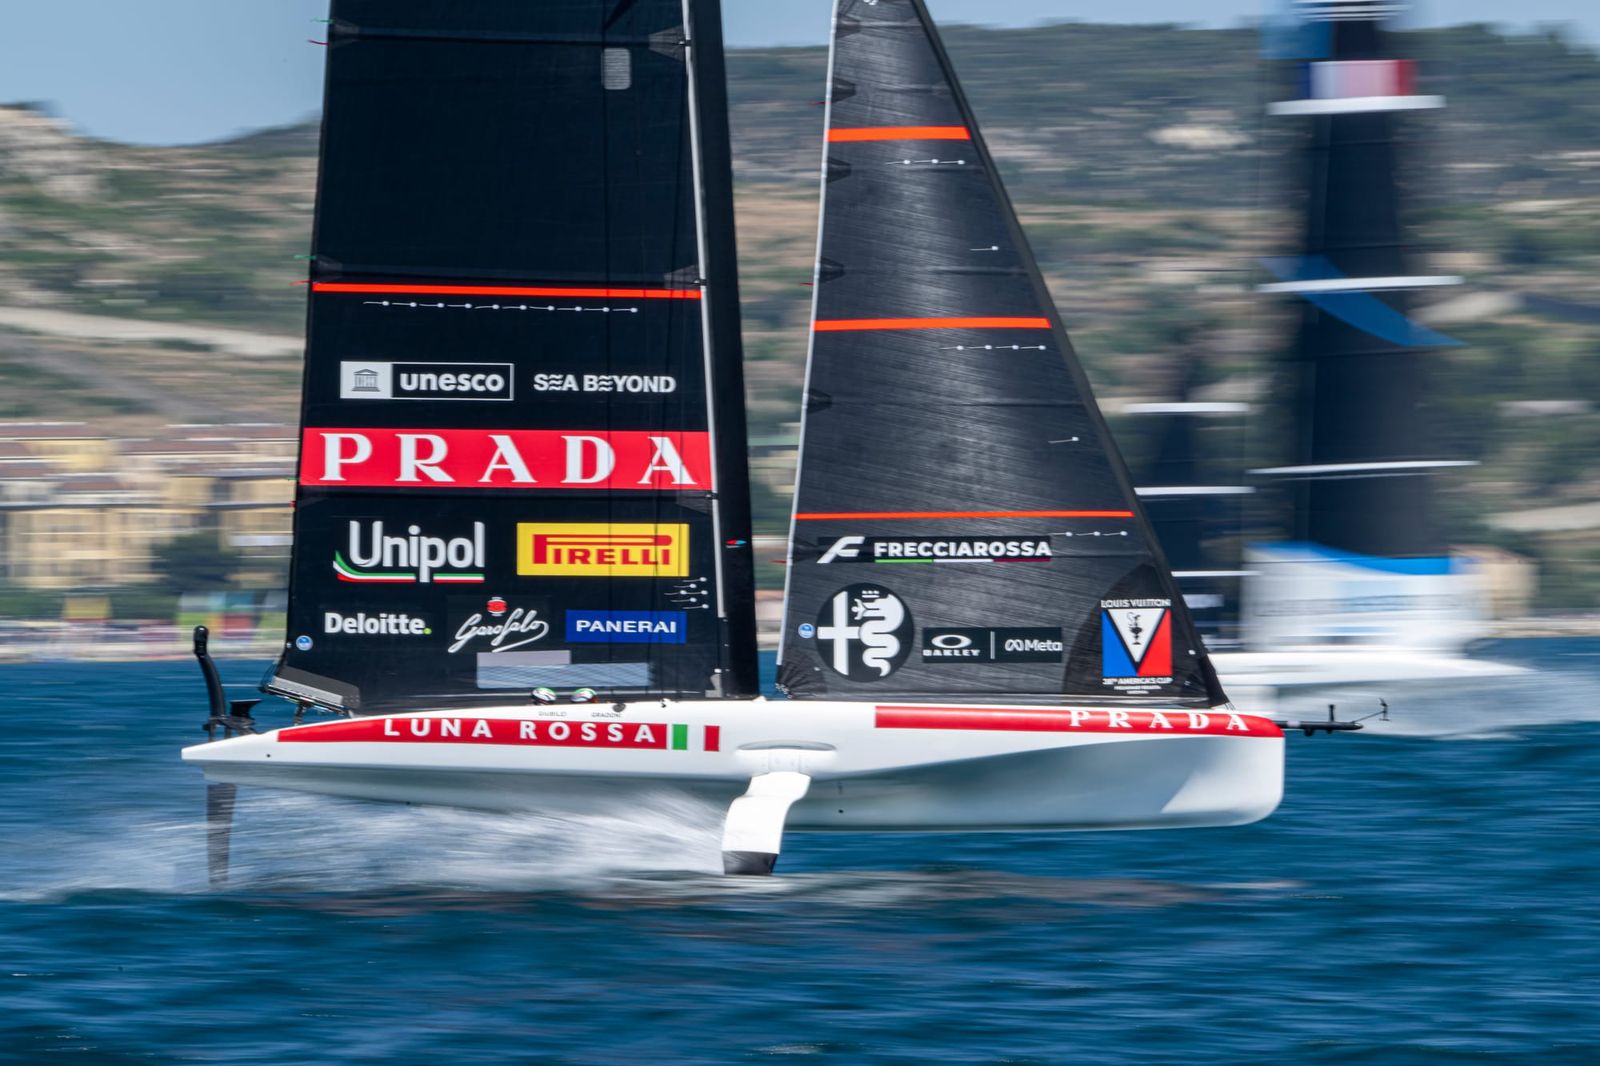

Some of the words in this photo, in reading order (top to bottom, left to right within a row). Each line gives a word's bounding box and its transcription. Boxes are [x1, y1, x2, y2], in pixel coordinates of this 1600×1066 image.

[400, 372, 504, 392] unesco
[533, 374, 579, 391] SEA
[583, 374, 676, 393] BEYOND
[319, 432, 697, 485] PRADA
[348, 520, 485, 583] Unipol
[532, 534, 673, 566] PIRELLI
[874, 541, 1053, 557] FRECCIAROSSA
[1100, 599, 1130, 609] LOUIS
[1130, 598, 1172, 608] VUITTON
[576, 619, 677, 634] PANERAI
[922, 649, 981, 657] OAKLEY
[1024, 638, 1063, 652] Meta
[383, 718, 493, 738] LUNA
[520, 721, 656, 742] ROSSA
[1069, 710, 1249, 731] PRADA
